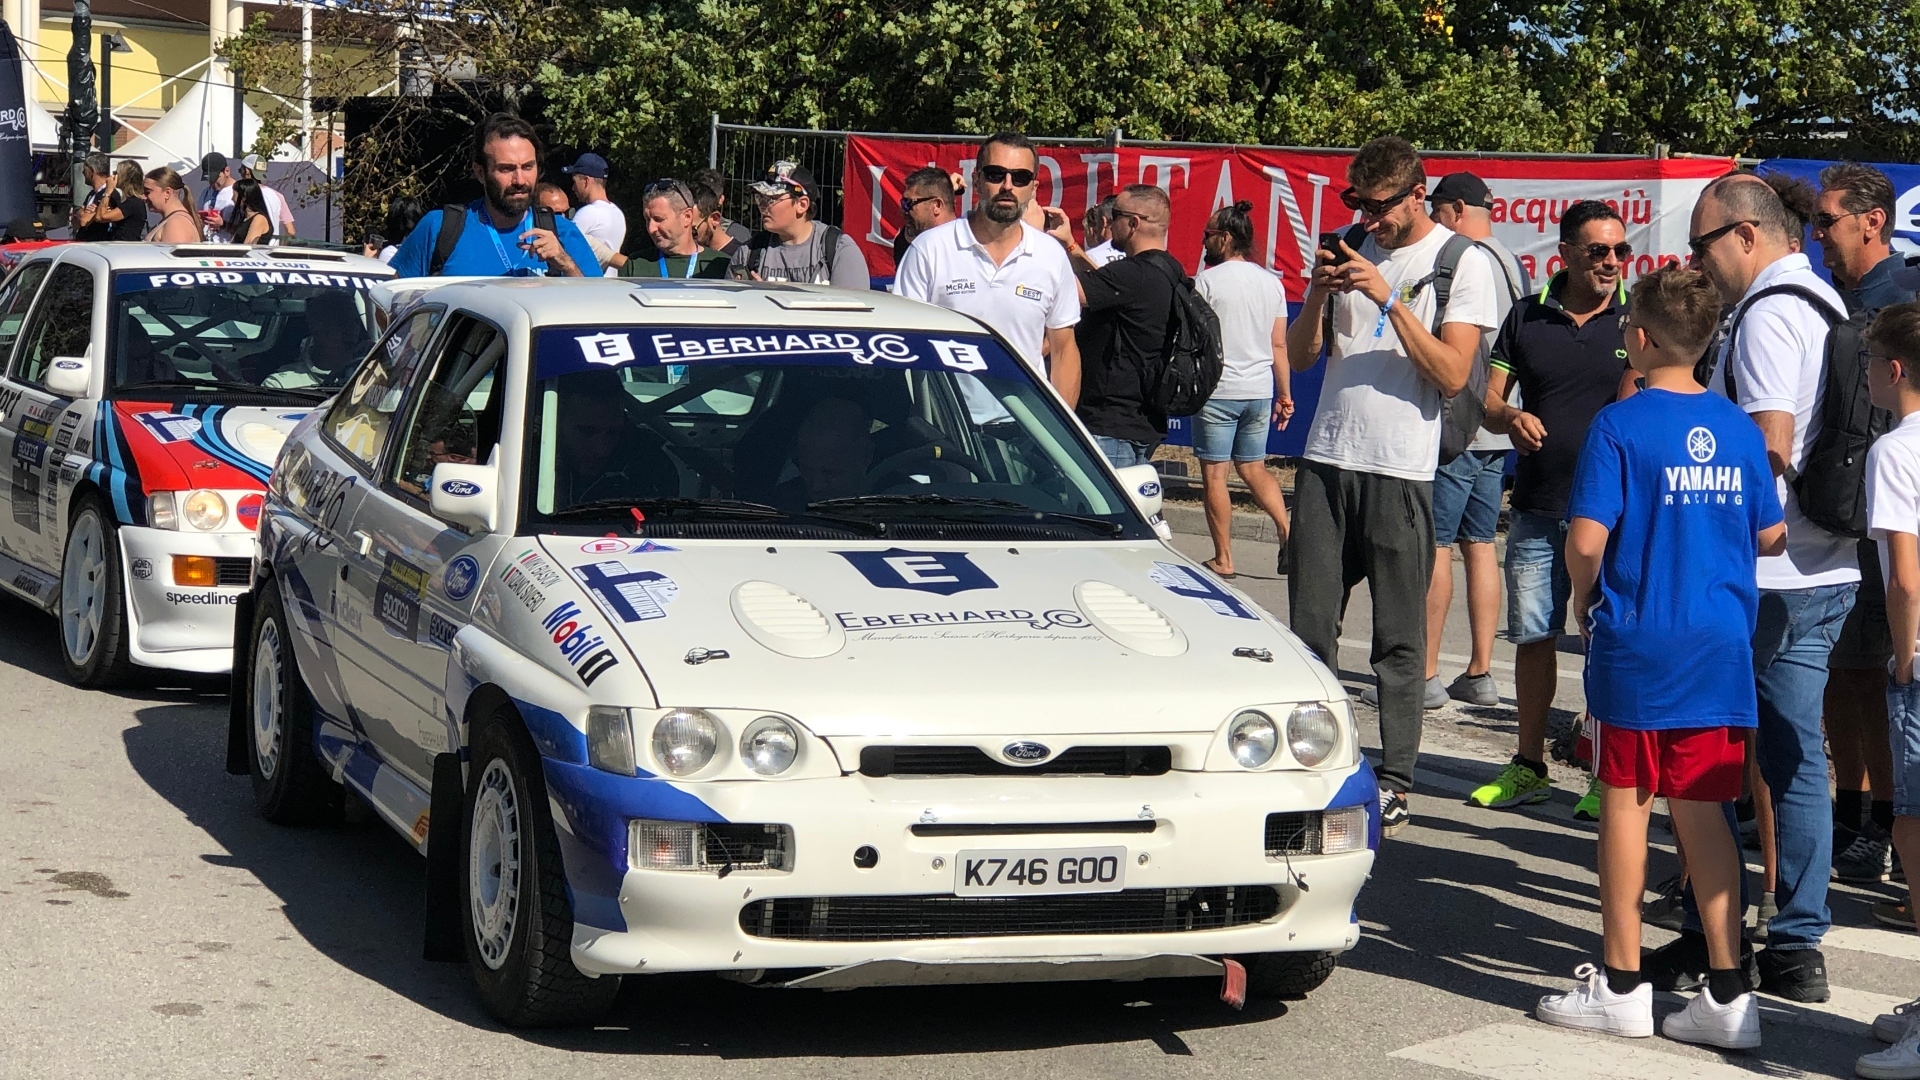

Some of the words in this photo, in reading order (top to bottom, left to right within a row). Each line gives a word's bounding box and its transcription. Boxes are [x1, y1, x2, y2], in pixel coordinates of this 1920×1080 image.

[149, 271, 244, 288] FORD
[945, 282, 976, 292] McRAE
[594, 338, 621, 359] E
[947, 346, 974, 364] E
[1665, 466, 1743, 491] YAMAHA
[447, 481, 475, 495] Ford
[1143, 483, 1158, 496] Ford
[1665, 493, 1743, 505] RACING
[447, 560, 472, 594] Ford
[881, 555, 961, 585] E
[166, 591, 239, 606] speedline
[382, 592, 410, 625] sparco
[541, 600, 605, 667] Mobil
[583, 653, 614, 680] 1
[852, 631, 929, 642] Manufacture
[931, 630, 970, 640] Suisse
[1042, 633, 1078, 642] depuis
[1014, 745, 1041, 759] Ford
[964, 857, 1050, 887] K746
[1057, 856, 1119, 885] GOO
